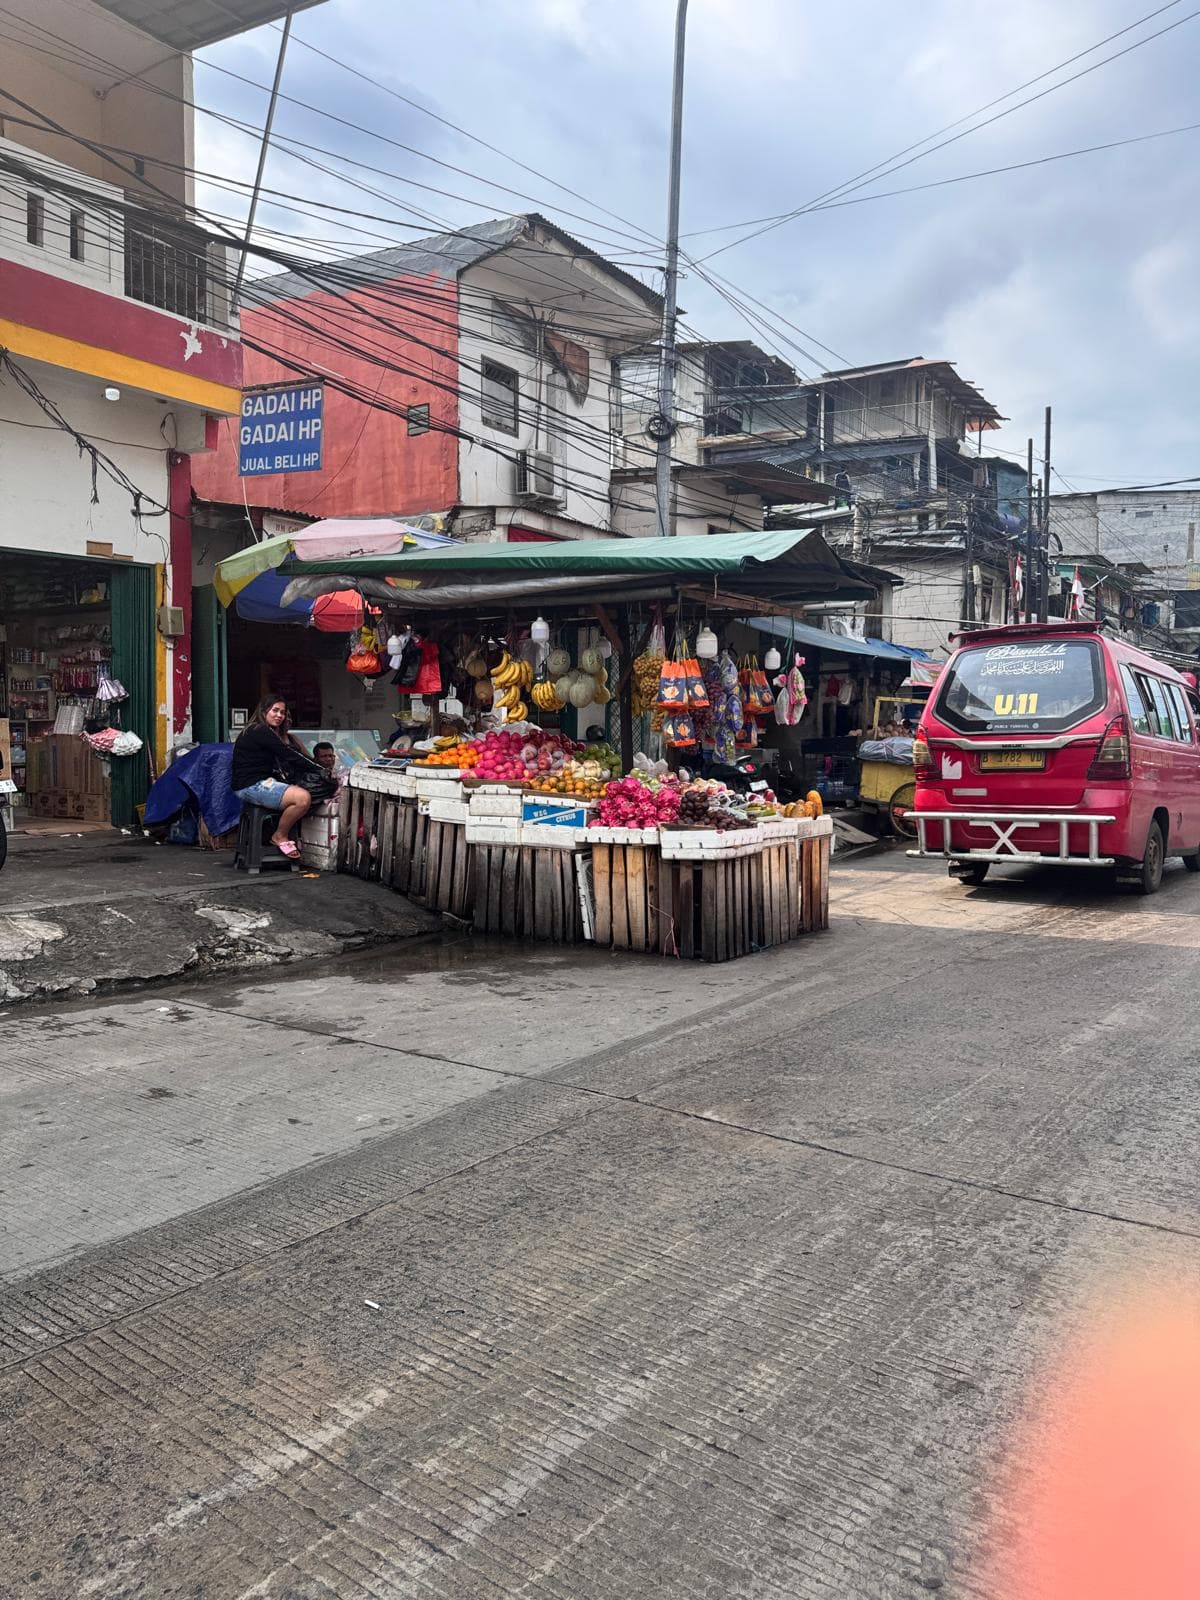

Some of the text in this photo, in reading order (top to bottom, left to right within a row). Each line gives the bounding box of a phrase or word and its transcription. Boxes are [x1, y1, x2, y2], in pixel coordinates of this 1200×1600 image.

[242, 388, 322, 417] GADAI HP
[240, 418, 322, 445] GADAI HP
[241, 452, 319, 472] JUAL BELI HP
[985, 643, 1068, 660] Bismillh
[994, 693, 1038, 715] U.11
[982, 752, 989, 763] B
[997, 751, 1022, 763] 1782
